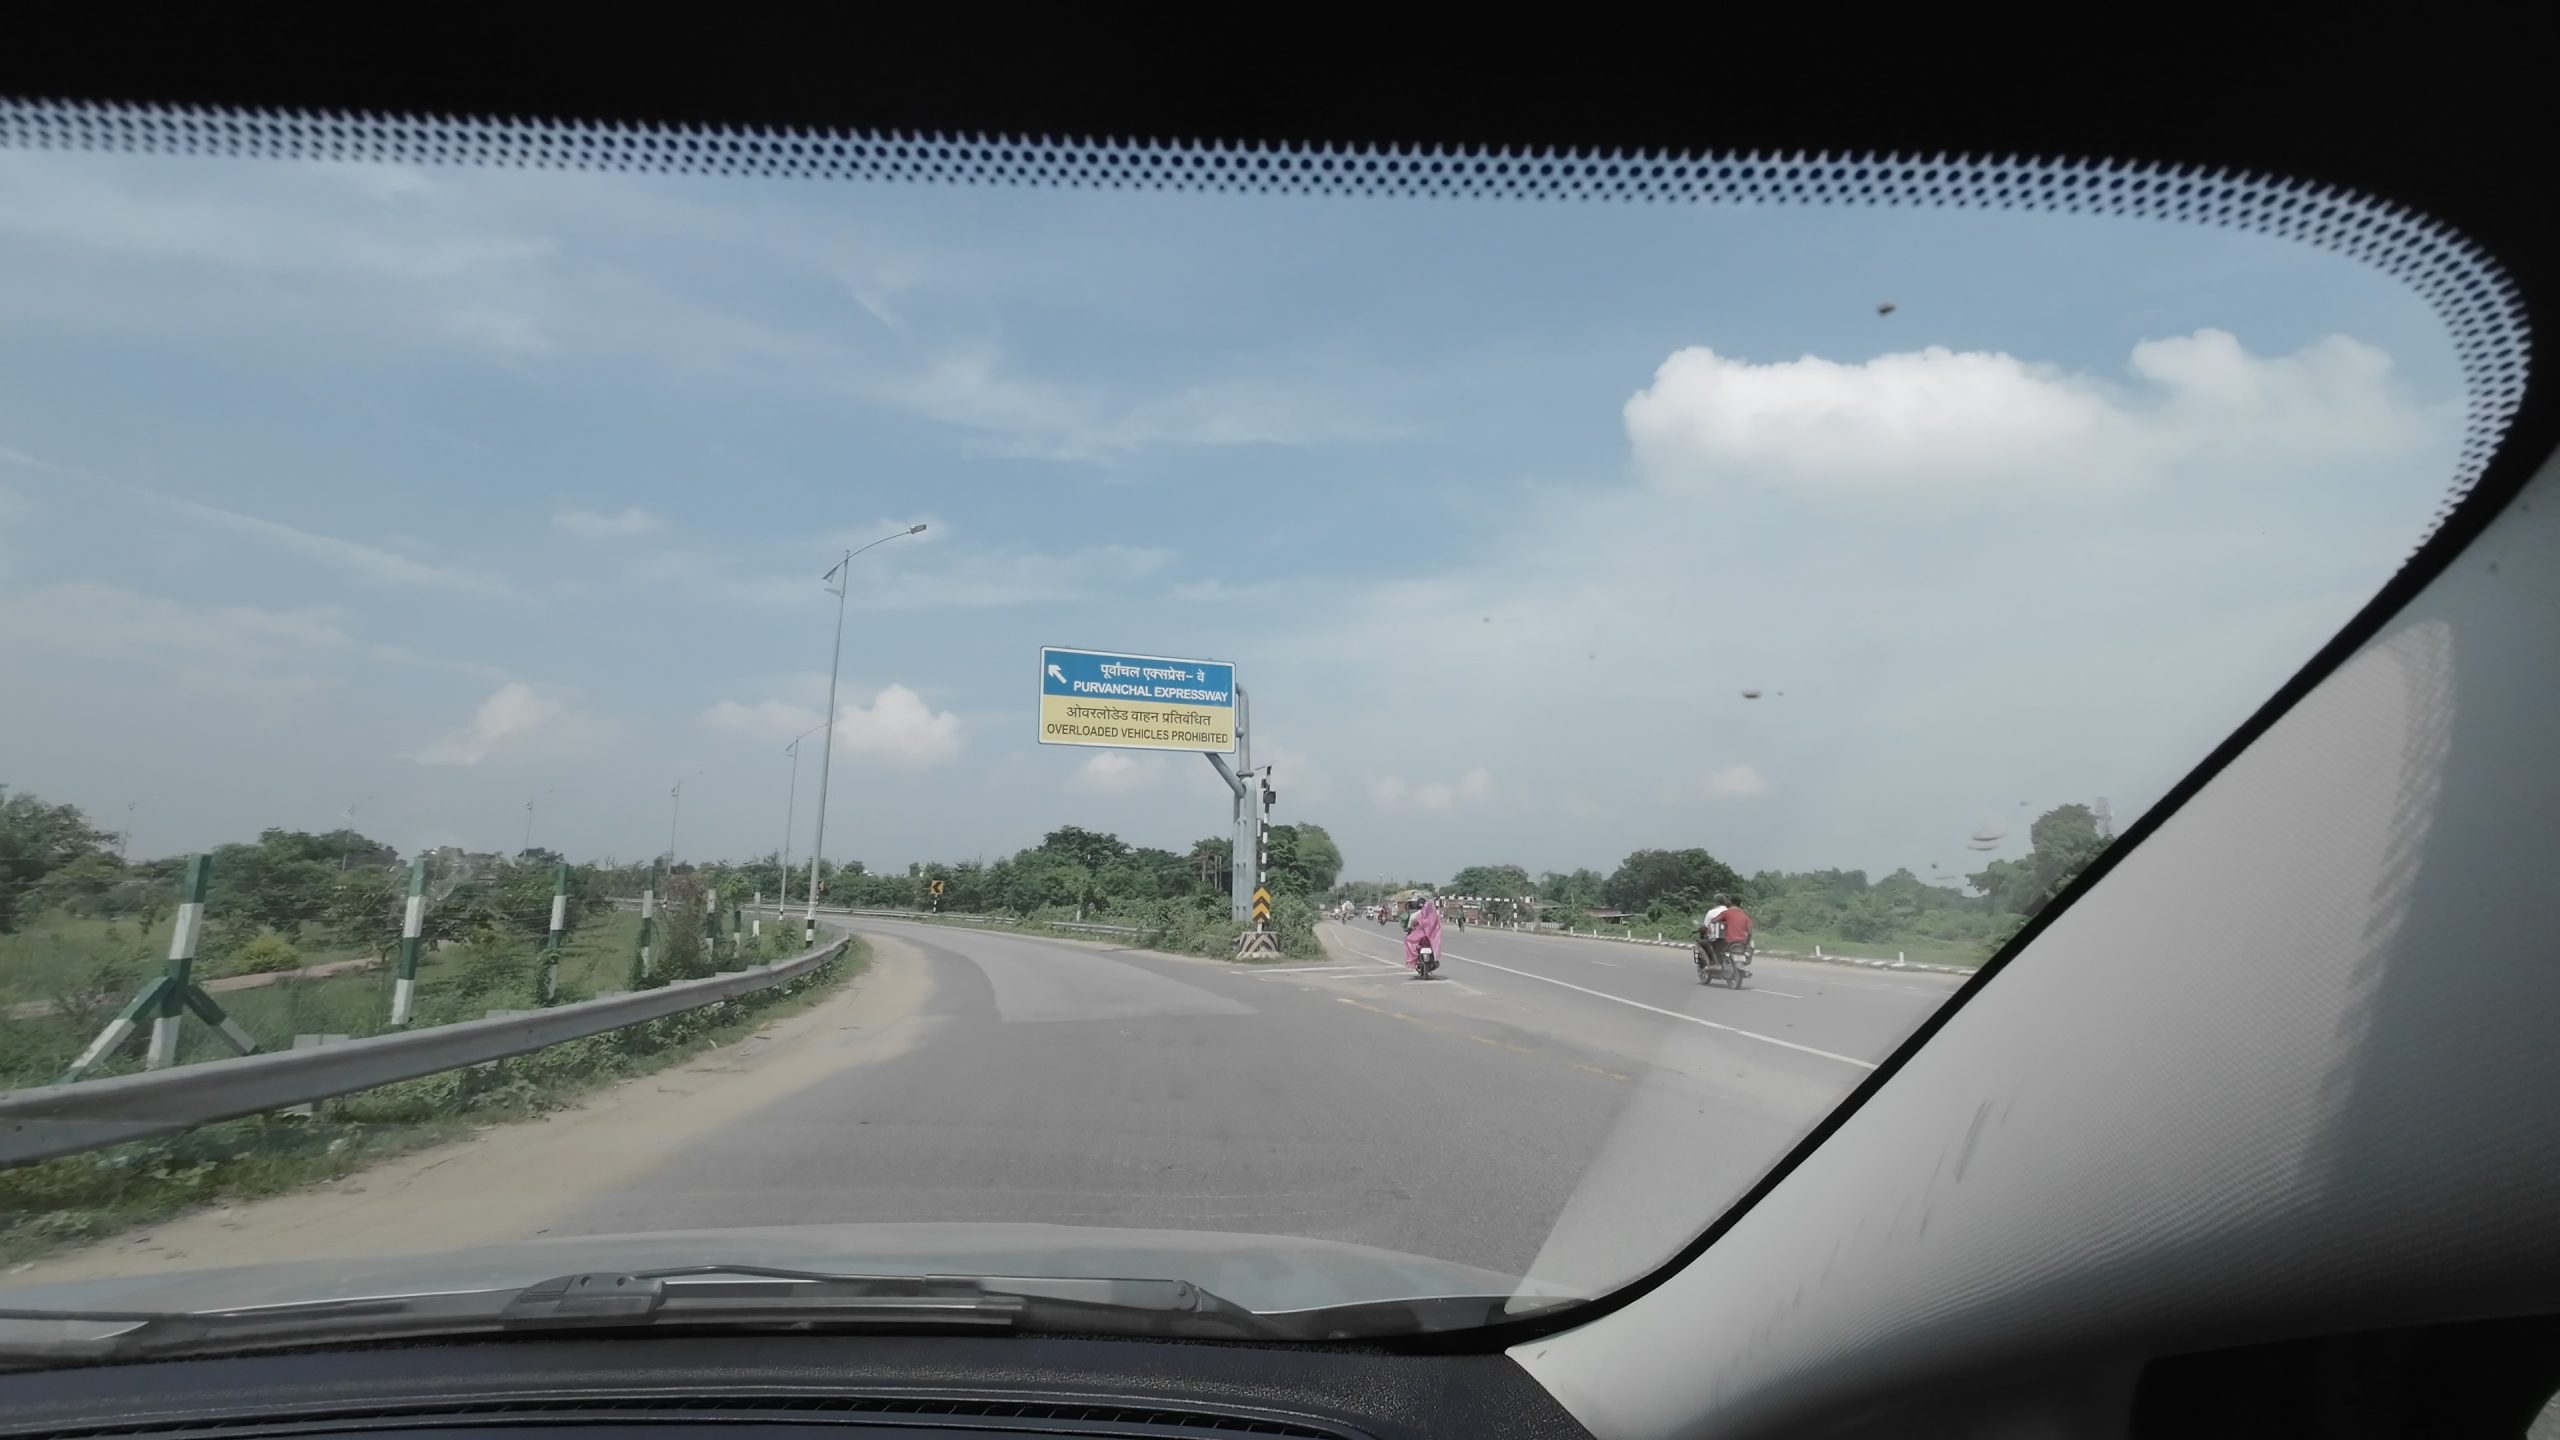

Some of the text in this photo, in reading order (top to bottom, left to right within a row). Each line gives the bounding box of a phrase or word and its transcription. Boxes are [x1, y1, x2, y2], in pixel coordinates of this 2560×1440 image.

[1073, 681, 1229, 702] PURVANCHAL EXPRESSWAY
[1066, 703, 1211, 726] ओवरलोडेड वाहन प्रतिबंधित
[1047, 723, 1228, 744] OVERLOADED VEHICLES PROHIBITED
